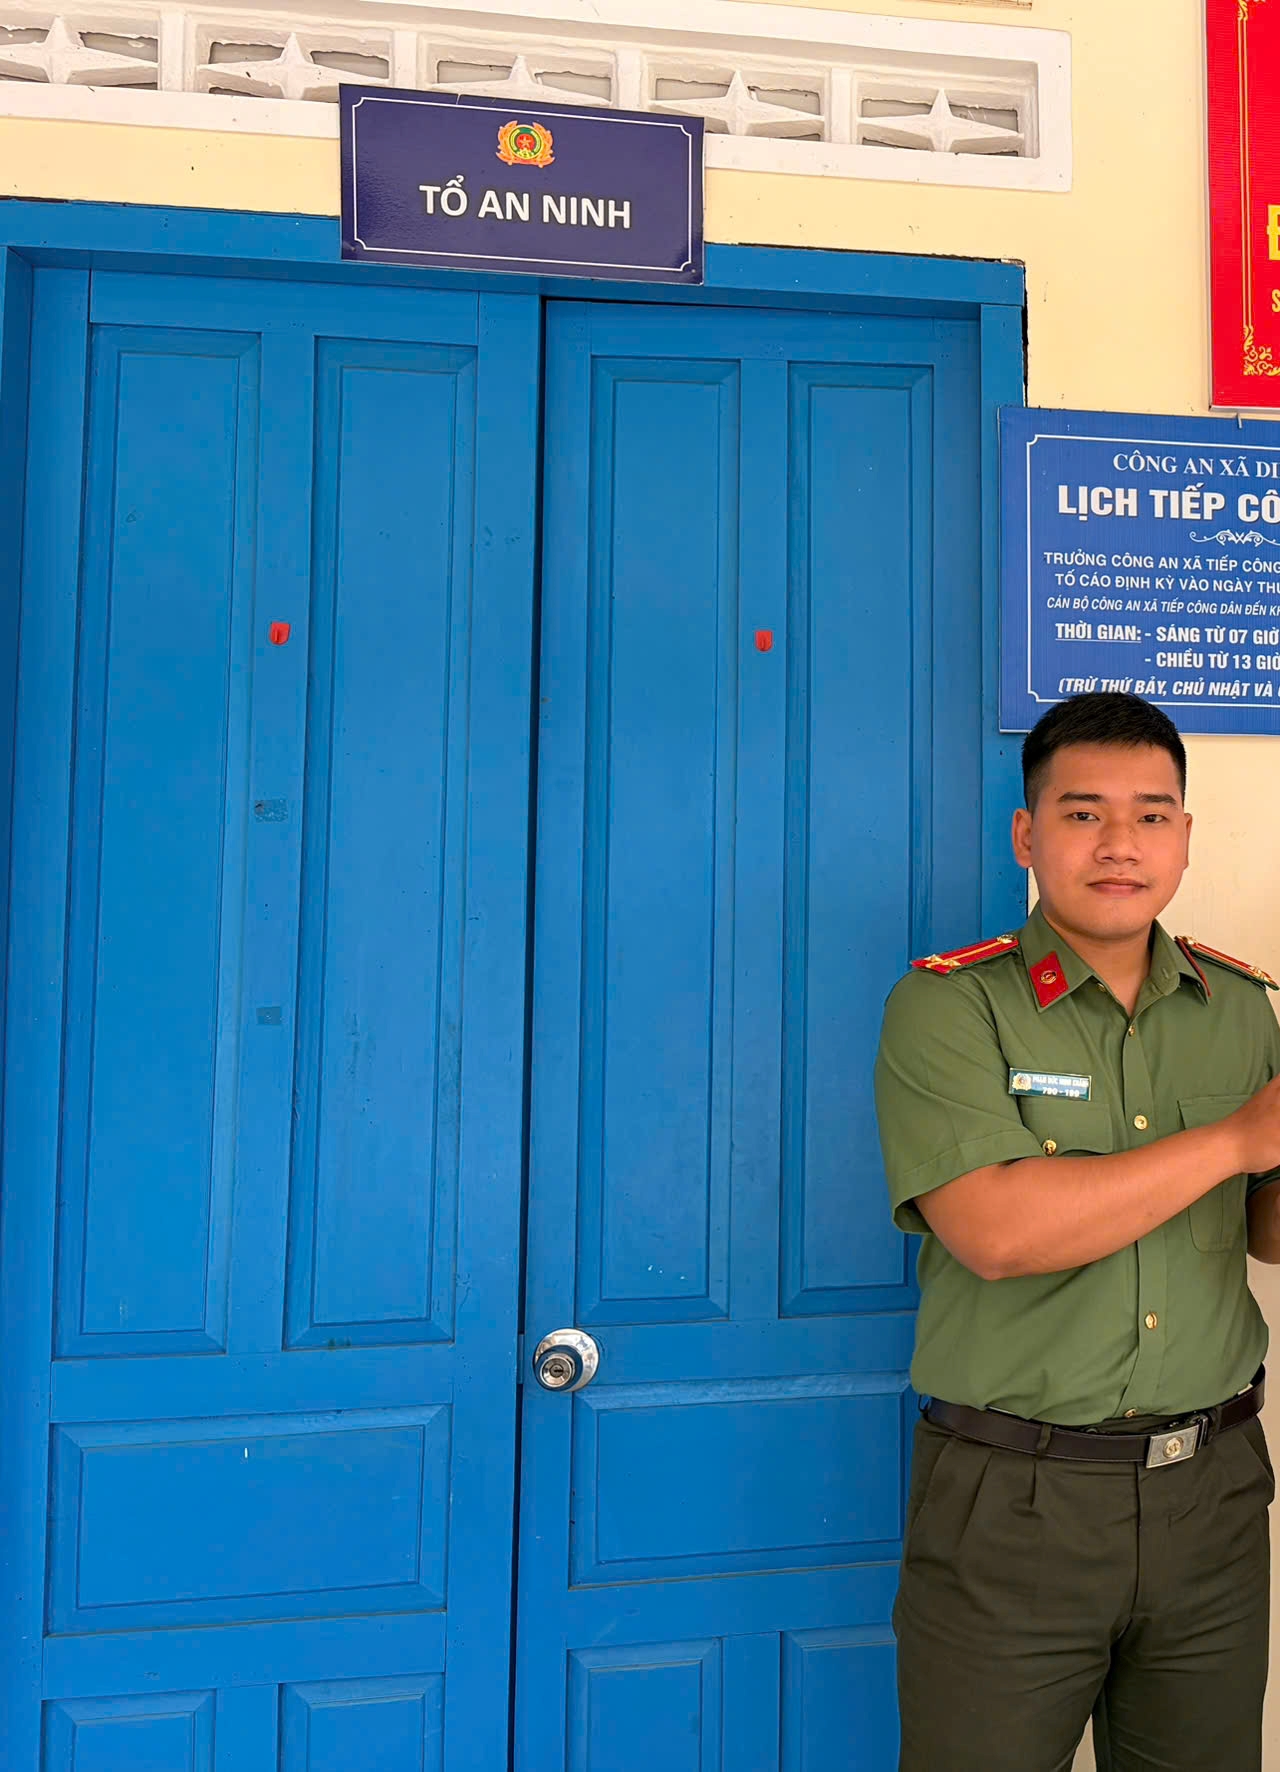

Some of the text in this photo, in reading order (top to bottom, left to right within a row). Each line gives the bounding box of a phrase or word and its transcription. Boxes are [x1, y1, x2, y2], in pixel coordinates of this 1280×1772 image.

[419, 175, 630, 228] TỔ AN NINH
[1113, 450, 1177, 473] CÔNG
[1184, 457, 1213, 475] AN
[1220, 455, 1249, 477] XÃ
[1058, 485, 1137, 521] LỊCH
[1149, 483, 1225, 520] TIẾP
[1043, 548, 1106, 566] TRƯỞNG
[1111, 552, 1154, 568] CÔNG
[1158, 557, 1178, 569] AN
[1183, 555, 1202, 570] XÃ
[1206, 554, 1238, 571] TIẾP
[1055, 569, 1076, 586] TỐ
[1079, 571, 1111, 588] CÁO
[1115, 575, 1150, 591] ĐỊNH
[1155, 574, 1174, 590] KỲ
[1179, 575, 1209, 591] VÀO
[1213, 577, 1252, 592] NGÀY
[1047, 595, 1070, 608] CÁN
[1072, 596, 1089, 611] BỘ
[1091, 596, 1123, 611] CÔNG
[1125, 600, 1141, 611] AN
[1143, 598, 1157, 612] XÃ
[1161, 598, 1184, 613] TIẾP
[1186, 599, 1217, 614] CÔNG
[1220, 600, 1242, 615] DÂN
[1244, 601, 1266, 616] ĐẾN
[1055, 620, 1092, 641] THỜI
[1097, 624, 1141, 643] GIAN:
[1156, 623, 1200, 643] SÁNG
[1204, 625, 1226, 643] TỪ
[1229, 629, 1248, 644] 07
[1253, 627, 1279, 645] GIỜ
[1156, 648, 1203, 668] CHIỀU
[1207, 650, 1229, 669] TỪ
[1233, 654, 1251, 669] 13
[1058, 675, 1098, 693] (TRỪ
[1100, 677, 1133, 694] THỨ
[1134, 676, 1166, 696] BẢY,
[1172, 677, 1204, 695] CHỦ
[1208, 680, 1250, 699] NHẬT
[1254, 680, 1272, 697] VÀ
